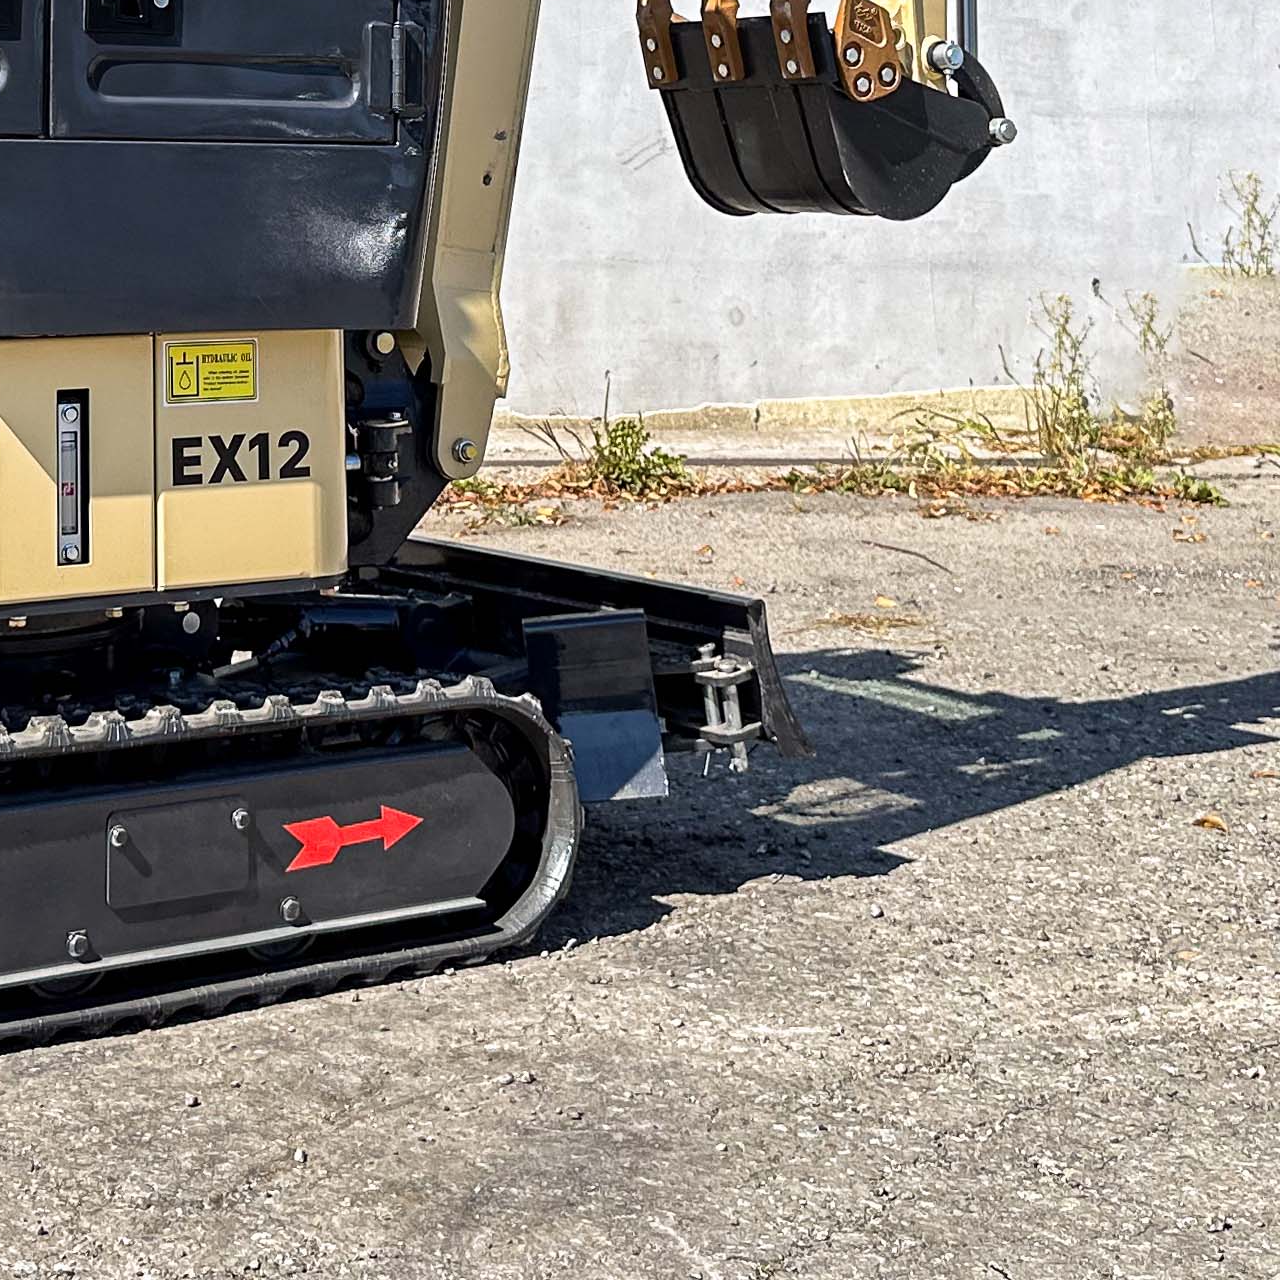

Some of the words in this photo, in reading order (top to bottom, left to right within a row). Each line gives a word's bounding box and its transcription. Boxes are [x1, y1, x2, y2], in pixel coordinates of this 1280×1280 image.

[201, 352, 238, 364] HYDRAULIC
[240, 351, 252, 362] OIL
[171, 430, 311, 486] EX12
